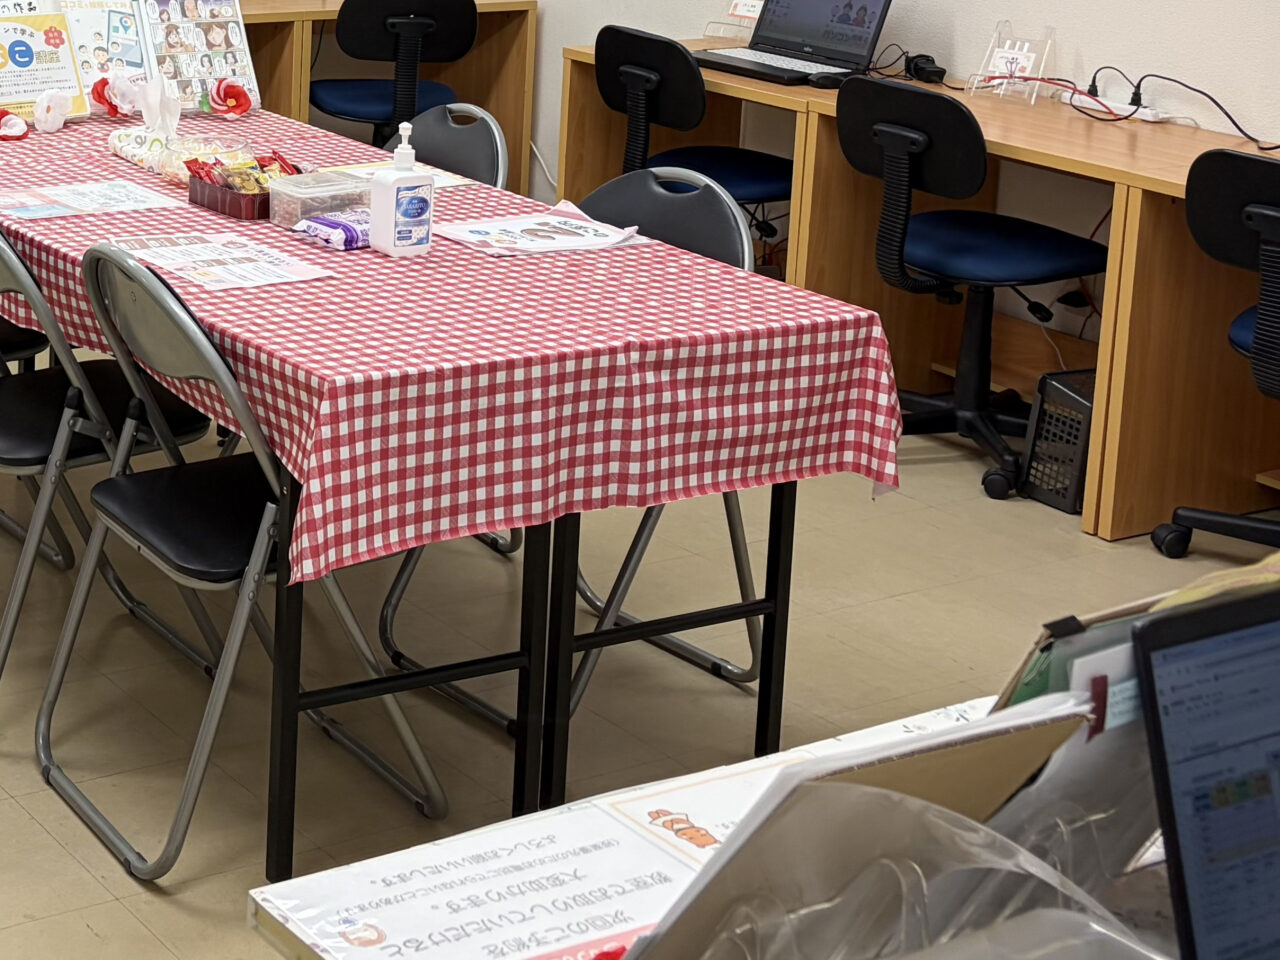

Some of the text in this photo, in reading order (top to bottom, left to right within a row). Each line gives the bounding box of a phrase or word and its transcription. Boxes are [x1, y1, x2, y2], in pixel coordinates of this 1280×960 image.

[380, 871, 673, 958] 教室でお取りしていただけると
